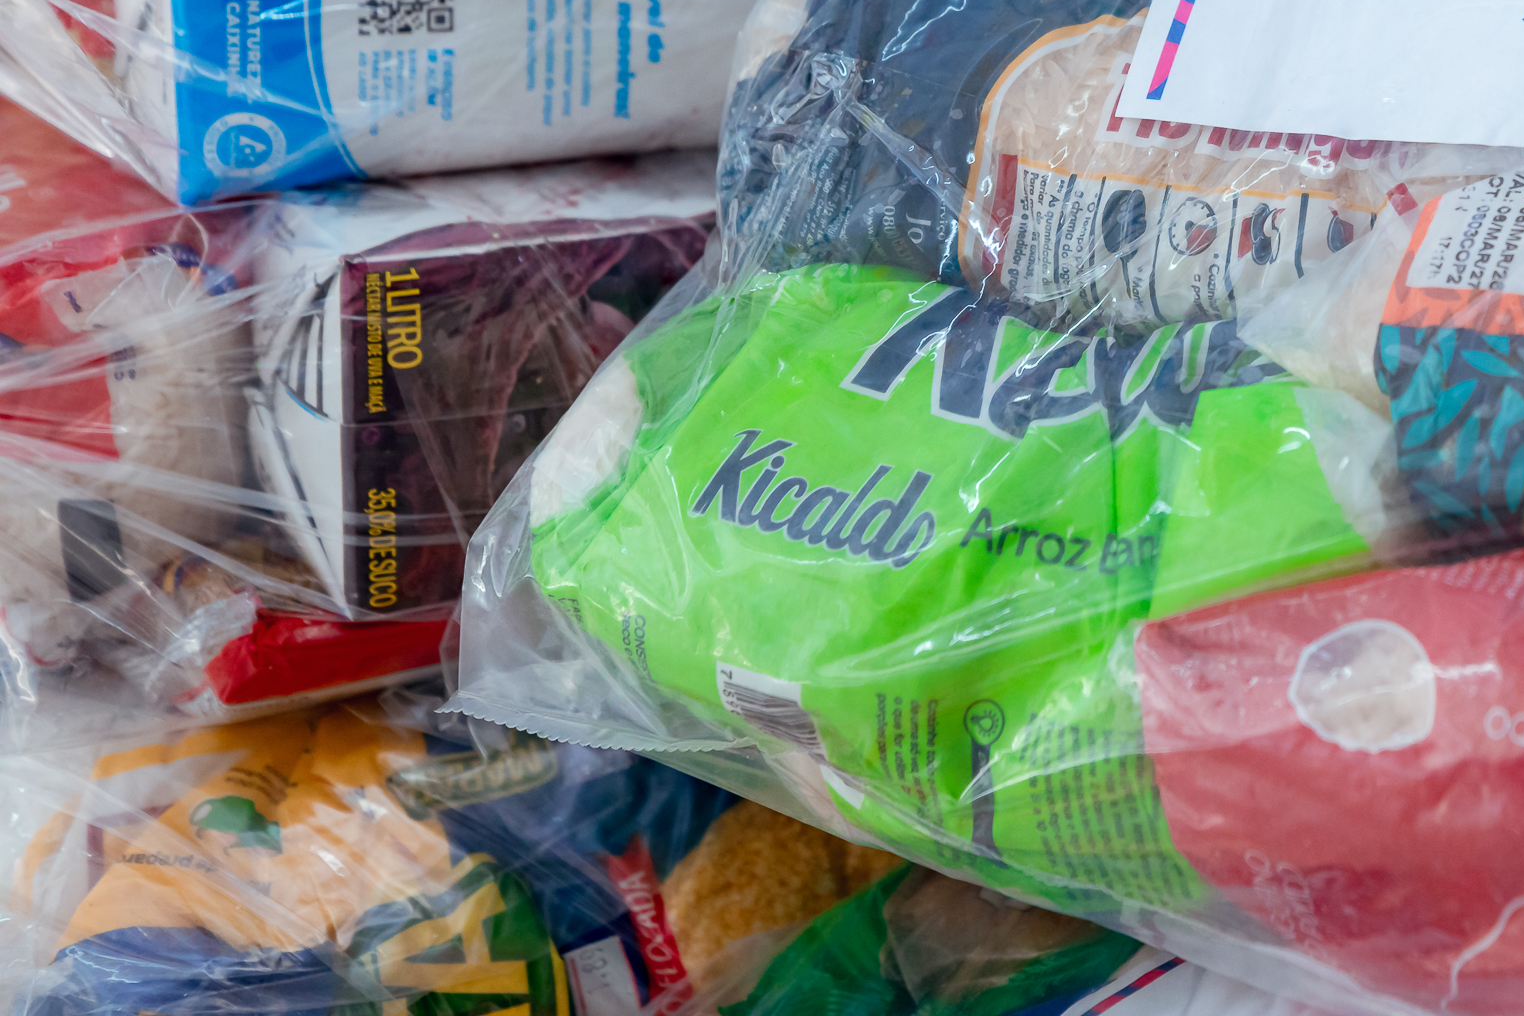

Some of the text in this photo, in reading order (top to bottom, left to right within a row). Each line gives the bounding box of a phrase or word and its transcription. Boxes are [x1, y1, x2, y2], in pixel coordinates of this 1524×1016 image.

[365, 273, 382, 312] NÉCTAR
[385, 267, 423, 370] 1 LITRO
[367, 343, 383, 358] DE
[365, 386, 387, 414] MAÇÃ
[690, 428, 1092, 572] Kicaldo Arroz
[364, 487, 397, 608] 35,0% DE SUCO
